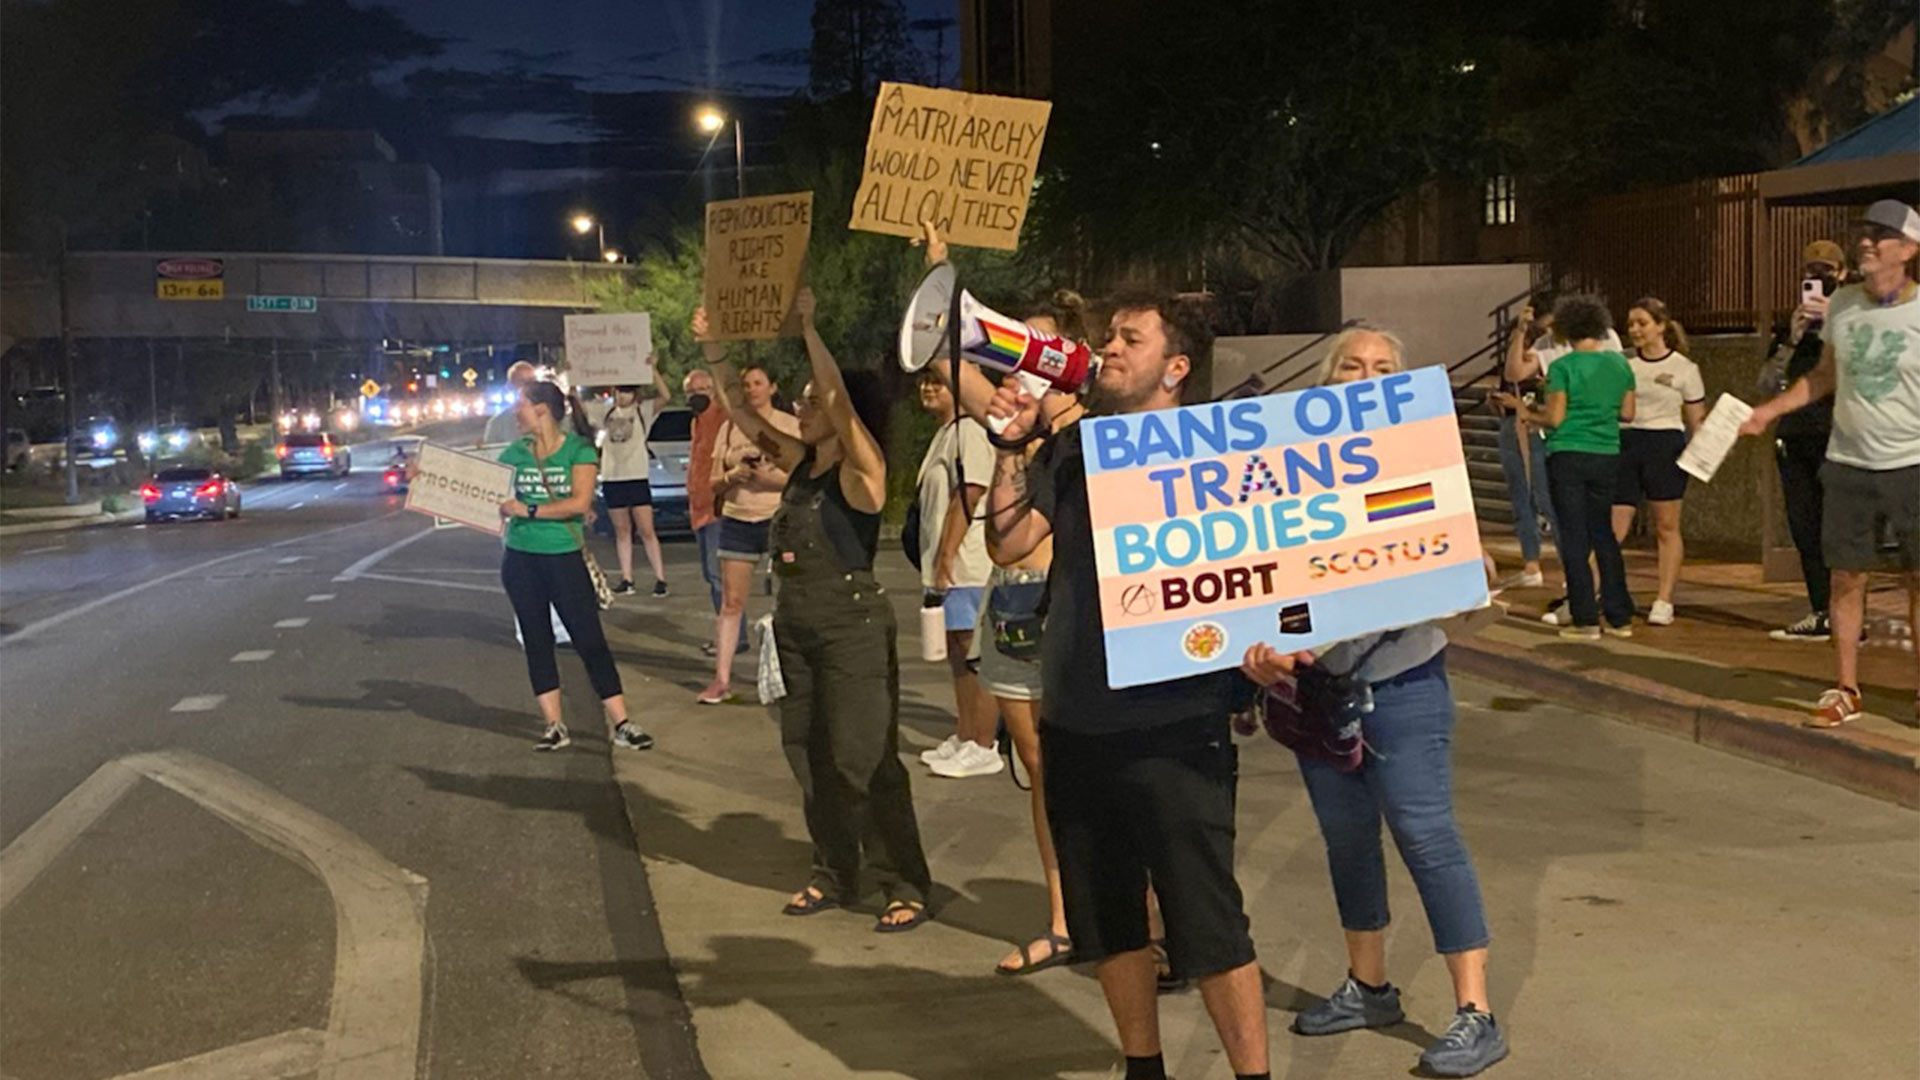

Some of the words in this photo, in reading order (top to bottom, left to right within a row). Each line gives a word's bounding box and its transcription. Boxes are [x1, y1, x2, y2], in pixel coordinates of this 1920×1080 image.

[888, 85, 905, 103] A
[878, 104, 1045, 160] MATRIARCHY
[869, 149, 940, 181] WOULD
[949, 157, 1028, 198] NEVER
[710, 200, 809, 235] REPRODUCTIVE
[860, 181, 959, 234] ALLOW
[963, 199, 1021, 231] THIS
[729, 234, 785, 265] RIGHTS
[739, 262, 769, 279] ARE
[717, 283, 783, 311] HUMAN
[721, 310, 783, 334] RIGHTS
[1093, 402, 1268, 471] BANS
[1294, 374, 1416, 436] OFF
[1148, 437, 1380, 518] TRANS
[1113, 493, 1347, 575] BODIES
[1308, 533, 1450, 579] SCOTUS
